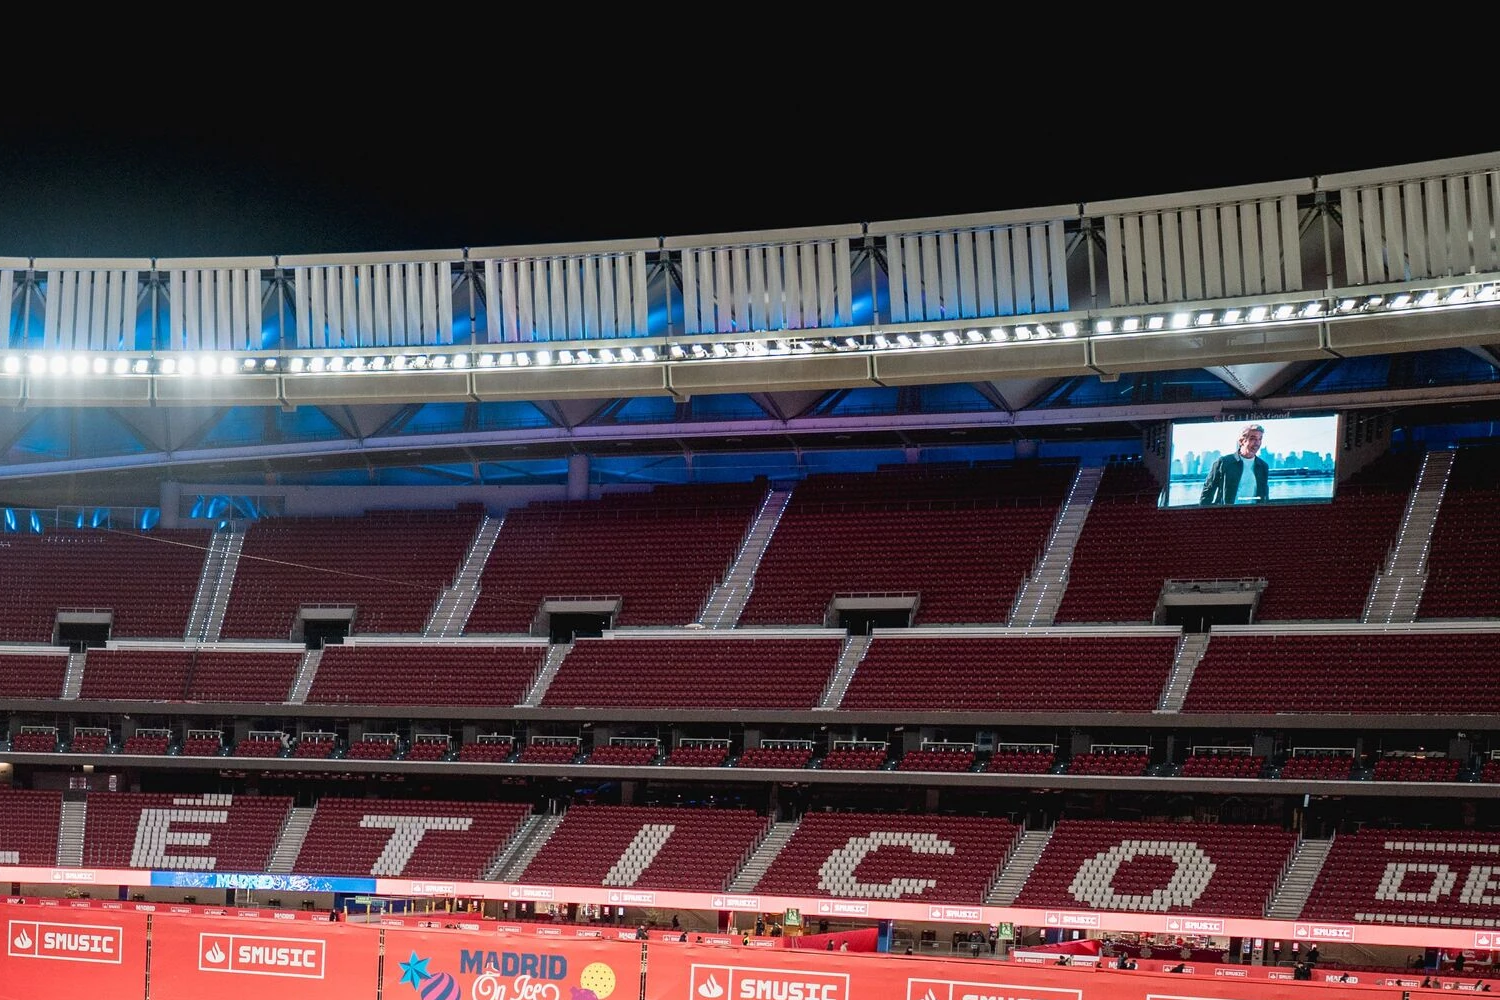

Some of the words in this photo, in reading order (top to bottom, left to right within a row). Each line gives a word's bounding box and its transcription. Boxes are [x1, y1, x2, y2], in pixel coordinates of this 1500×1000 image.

[216, 873, 271, 889] MADRID
[945, 908, 978, 919] SMUSIC
[1063, 914, 1097, 925] SMUSIC
[1184, 920, 1221, 932] SMUSIC
[1313, 927, 1350, 938] SMUSIC
[43, 932, 114, 954] SMUSIC
[238, 945, 316, 968] SMUSIC
[459, 948, 567, 980] MADRID
